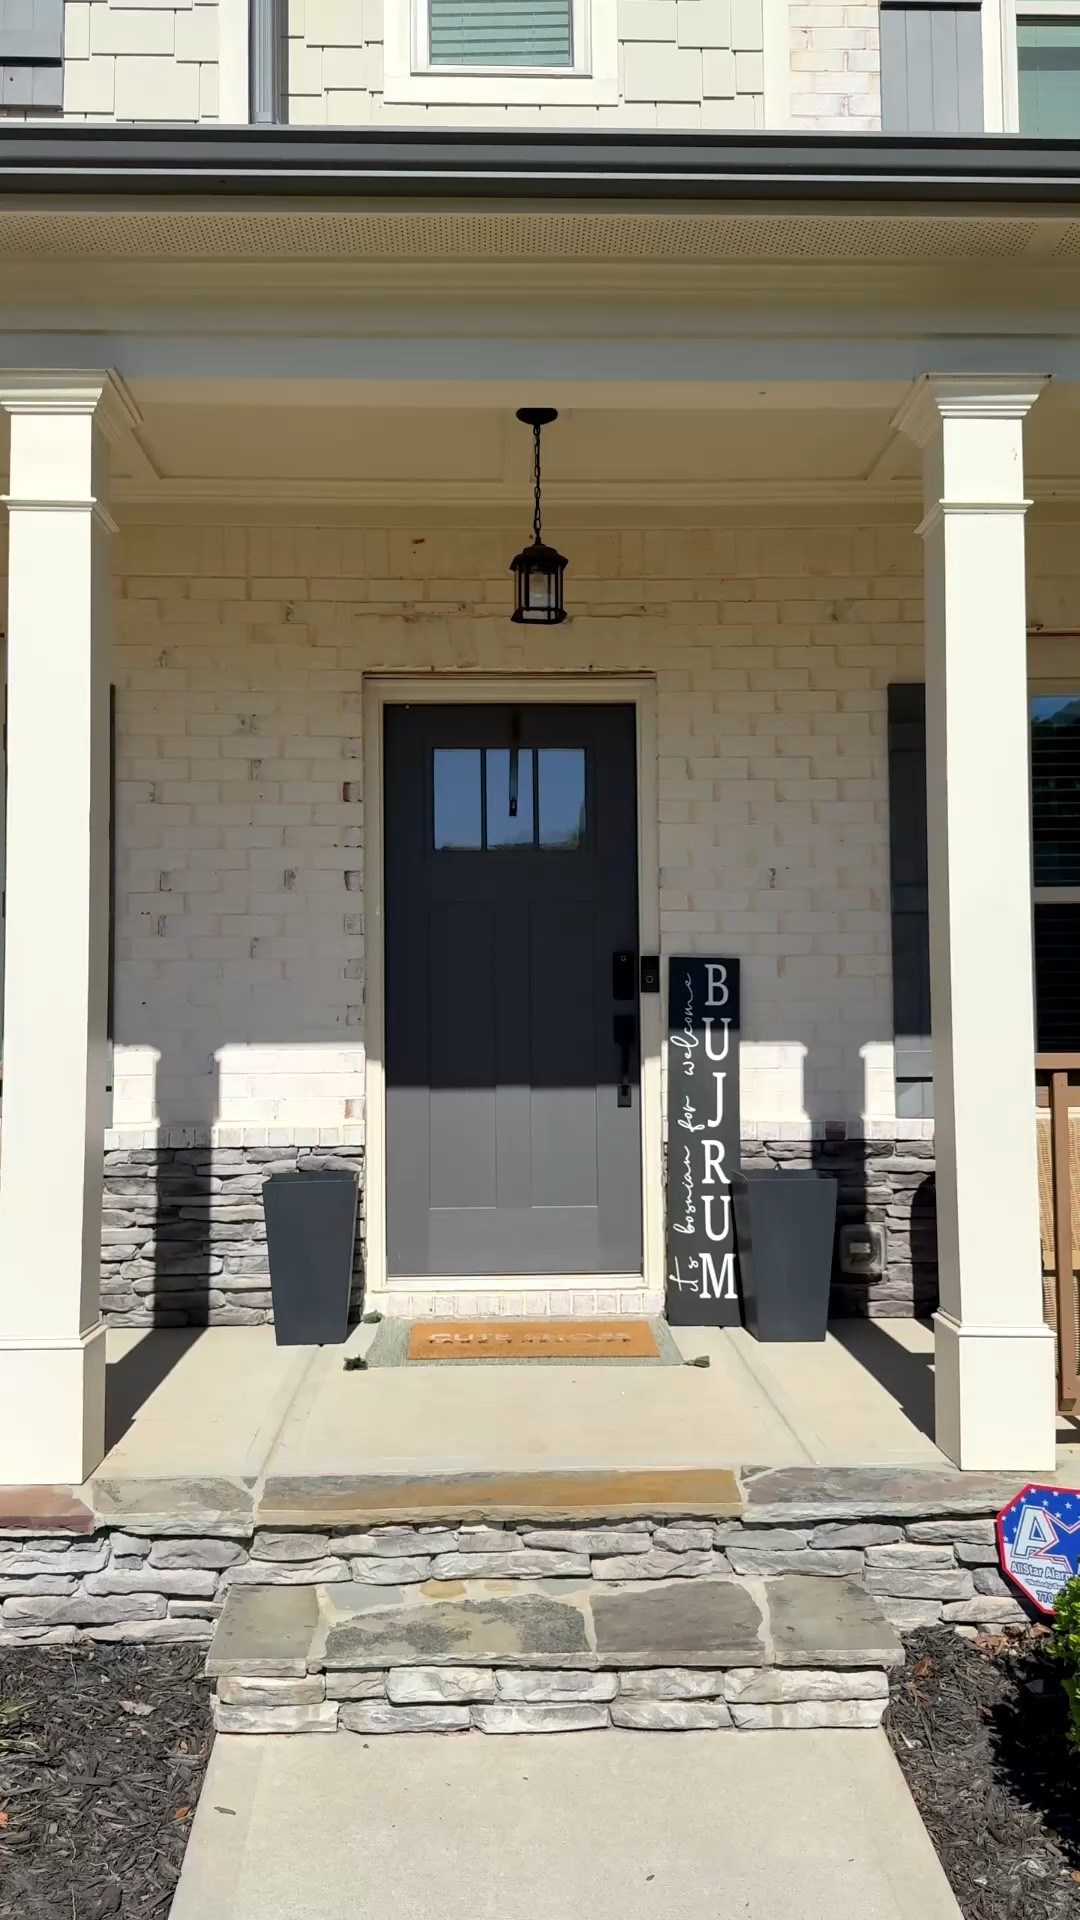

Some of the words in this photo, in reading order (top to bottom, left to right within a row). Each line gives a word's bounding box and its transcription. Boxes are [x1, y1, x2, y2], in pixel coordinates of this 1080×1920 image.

[670, 972, 699, 1076] welcome
[677, 1095, 705, 1133] for
[699, 964, 739, 1299] BUJRUM
[673, 1145, 696, 1234] bosnian
[1011, 1561, 1044, 1578] AllStar
